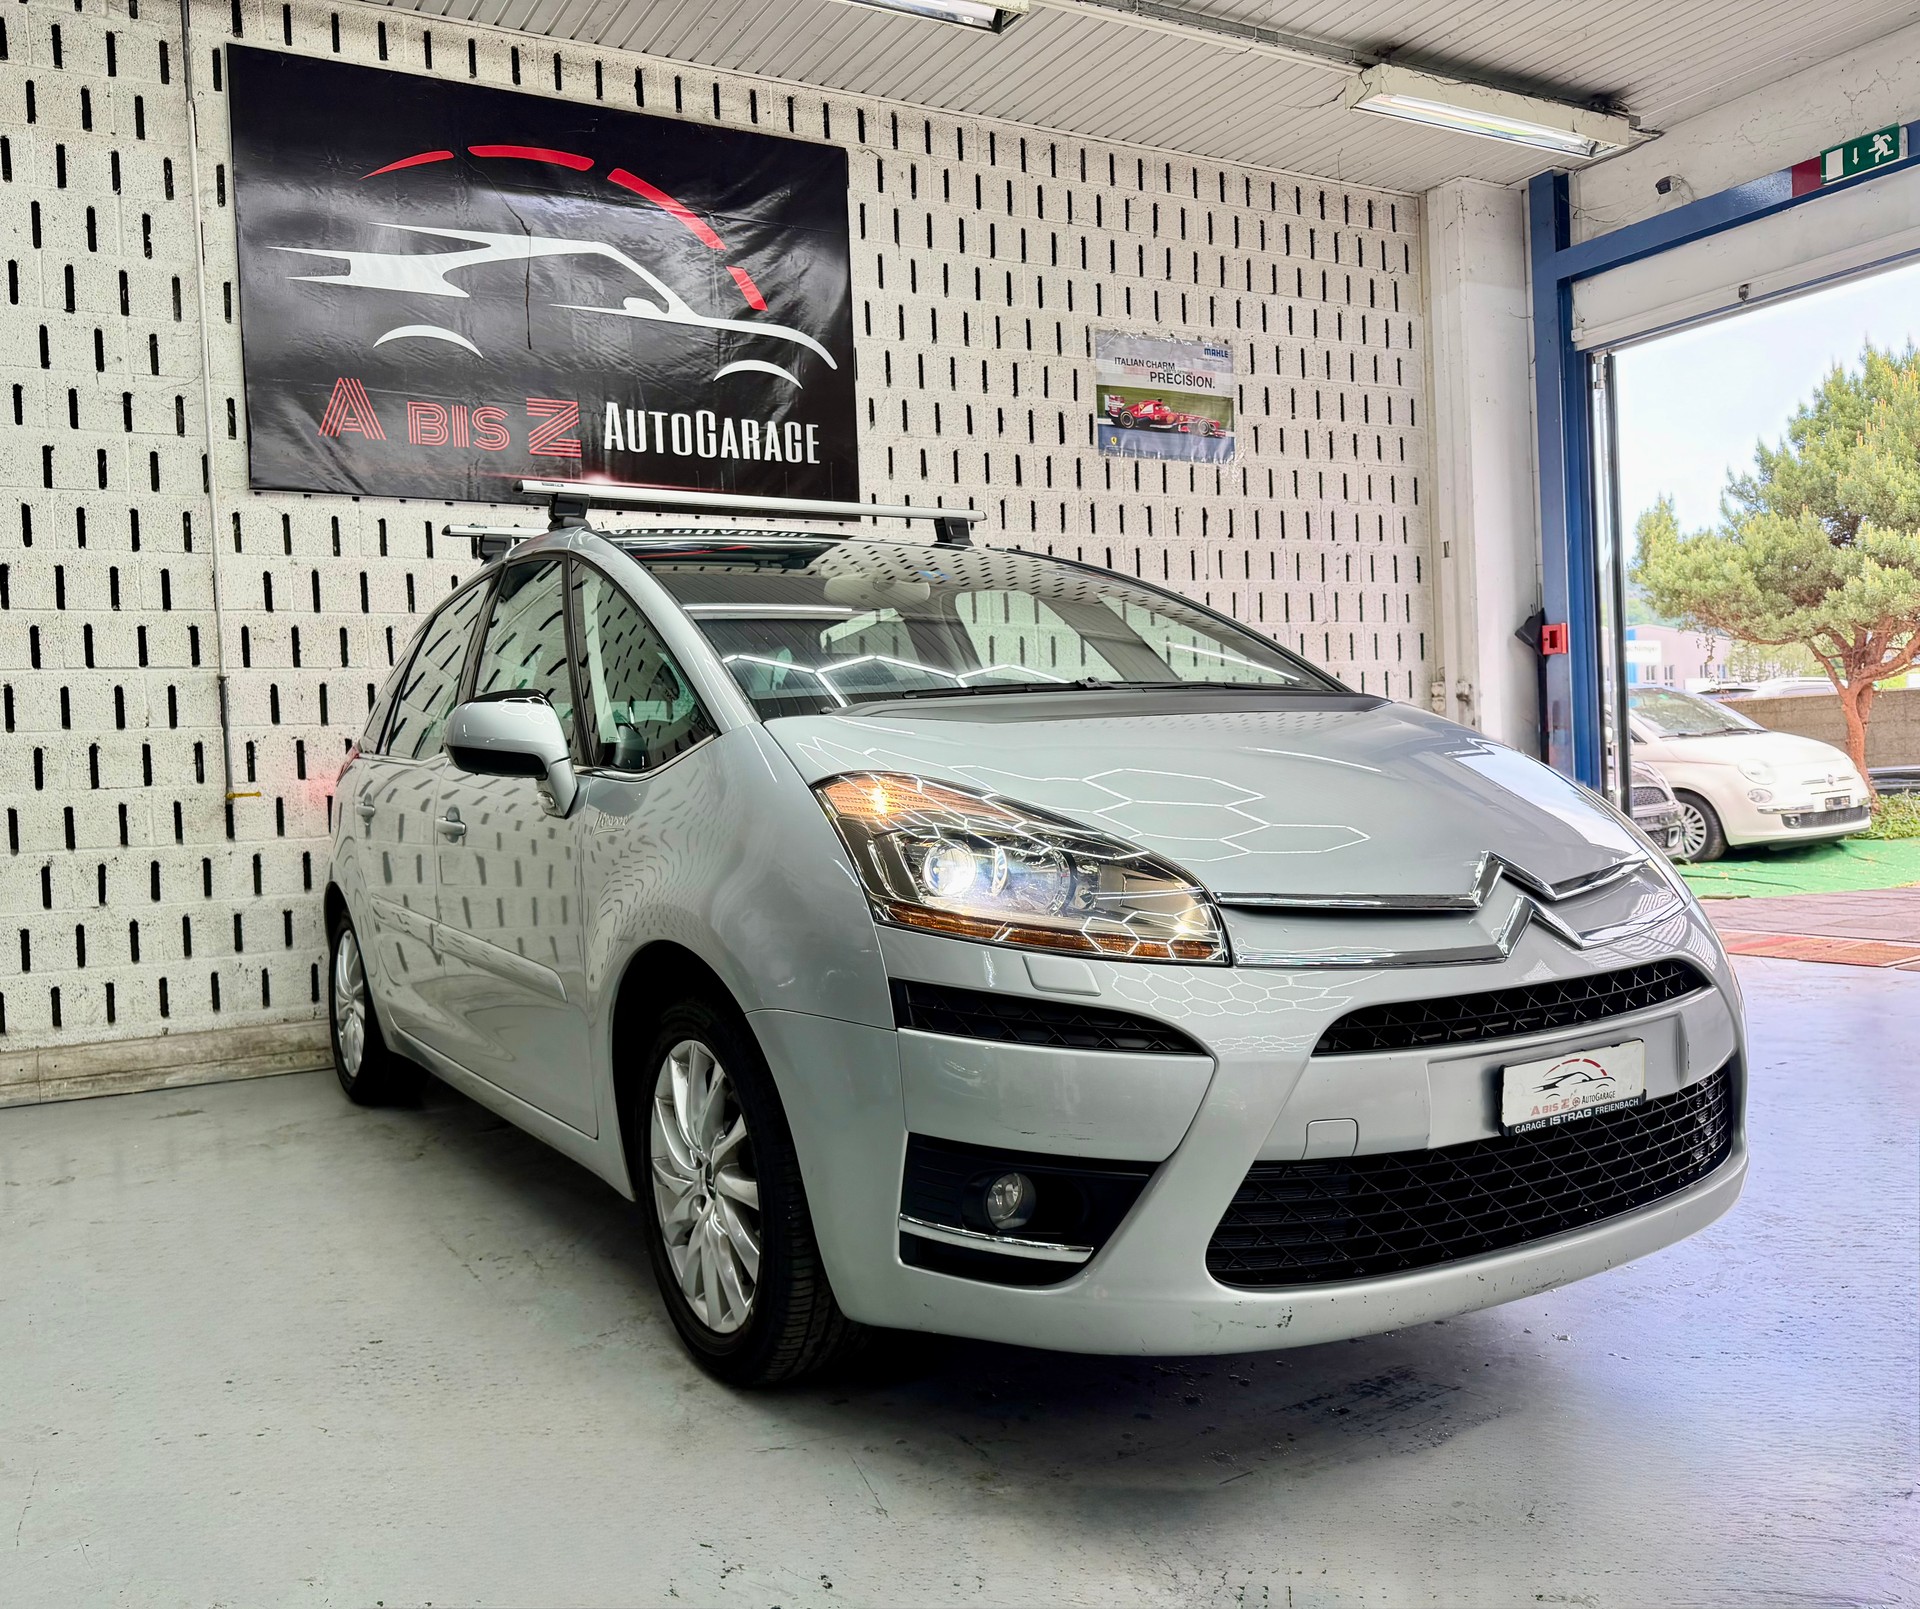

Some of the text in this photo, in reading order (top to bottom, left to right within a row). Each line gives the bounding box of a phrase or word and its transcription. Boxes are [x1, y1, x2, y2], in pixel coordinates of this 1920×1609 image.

[1203, 347, 1229, 358] MAHLE
[1114, 356, 1176, 371] ITALIAN CHARM
[1149, 371, 1216, 389] PRECISION.
[317, 377, 821, 464] A BIS Z AUTOGARAGE
[1514, 1098, 1639, 1134] GARAGE ISTRAG FREIENBACH
[1530, 1105, 1541, 1117] A
[1542, 1102, 1560, 1114] BIS
[1561, 1098, 1570, 1110] Z
